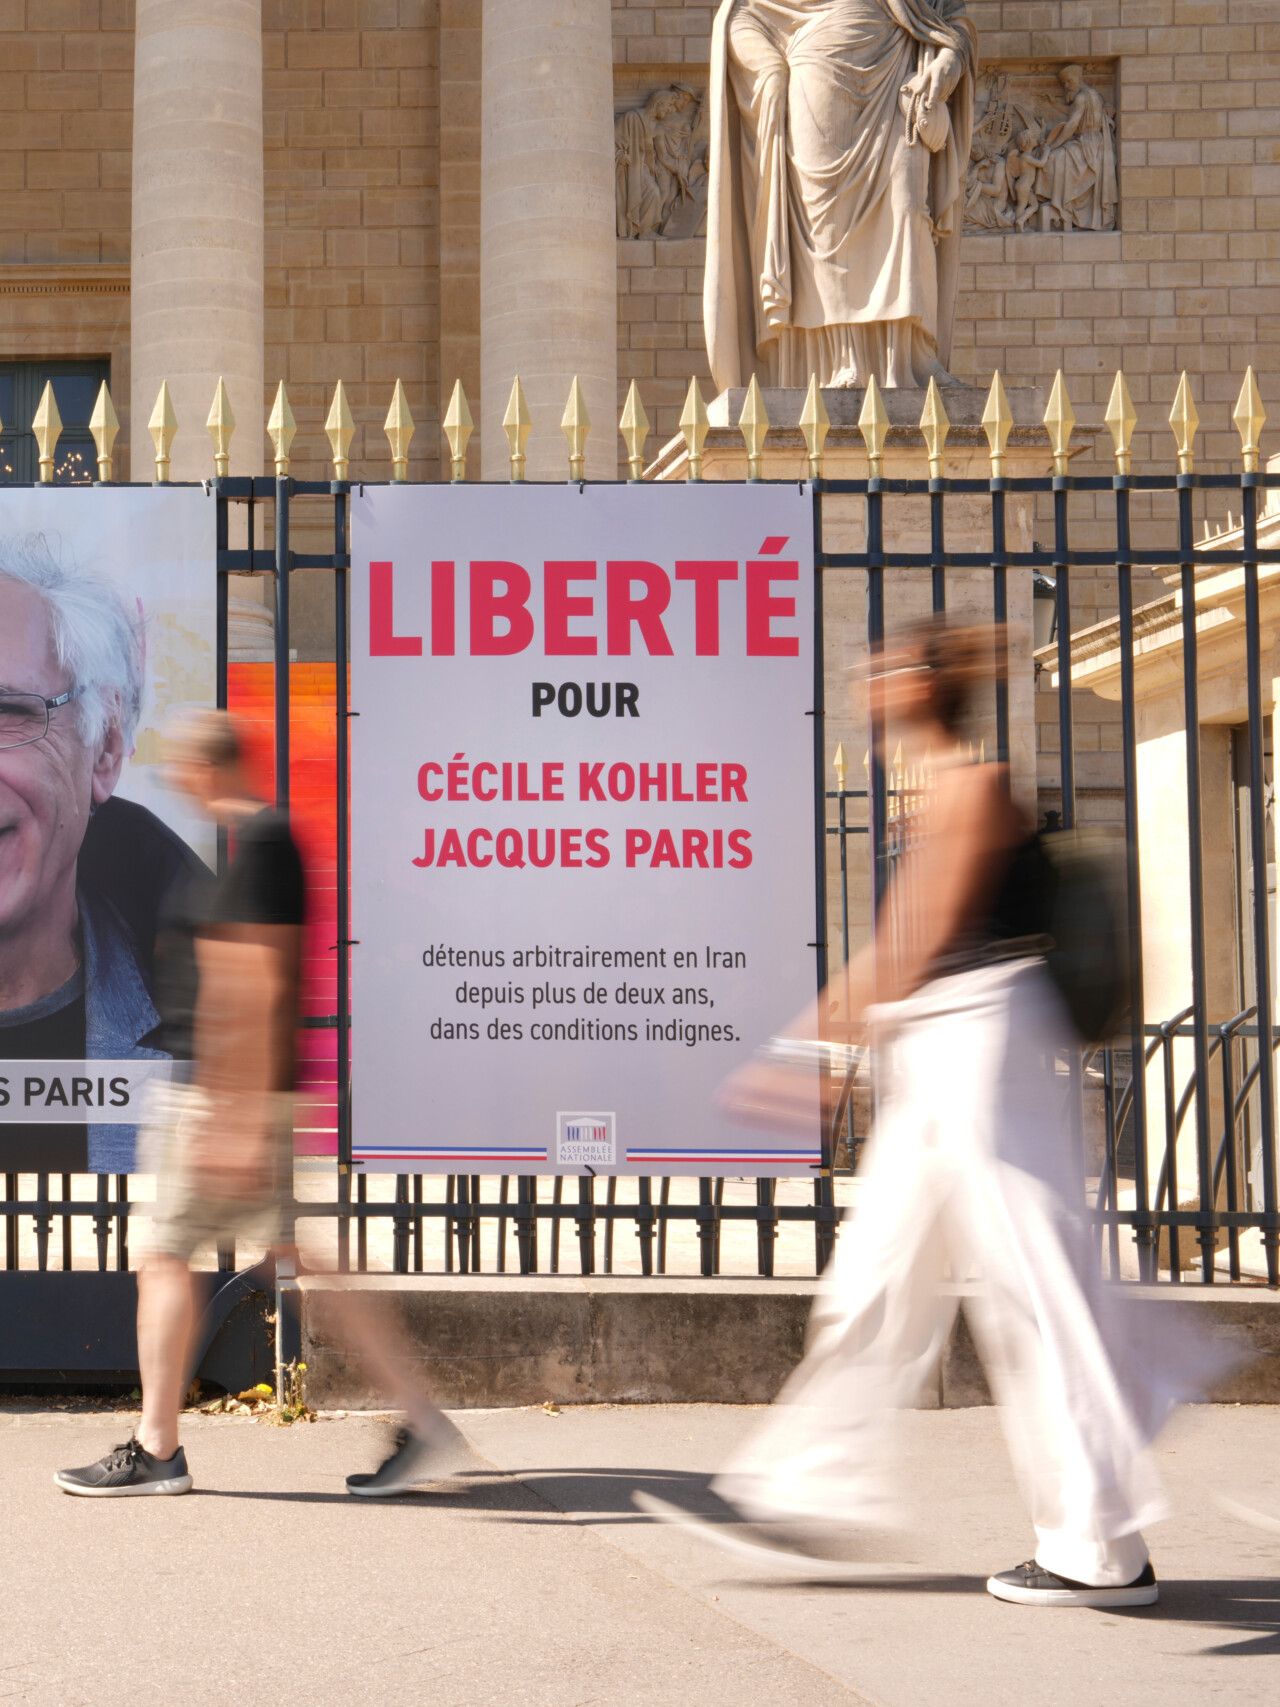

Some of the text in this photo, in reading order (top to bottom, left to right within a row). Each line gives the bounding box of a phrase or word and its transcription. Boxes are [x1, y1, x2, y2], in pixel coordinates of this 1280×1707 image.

[369, 536, 799, 657] LIBERTÉ
[532, 682, 640, 717] POUR
[417, 753, 748, 802] CÉCILE KOHLER
[412, 828, 753, 869] JACQUES PARIS
[422, 944, 747, 968] détenus arbitrairement en Iran
[455, 981, 714, 1009] depuis plus de deux ans,
[430, 1017, 740, 1047] dans des conditions indignes.
[24, 1077, 130, 1107] PARIS
[560, 1145, 613, 1153] ASSEMBLÉE
[560, 1153, 613, 1162] NATIONALE
